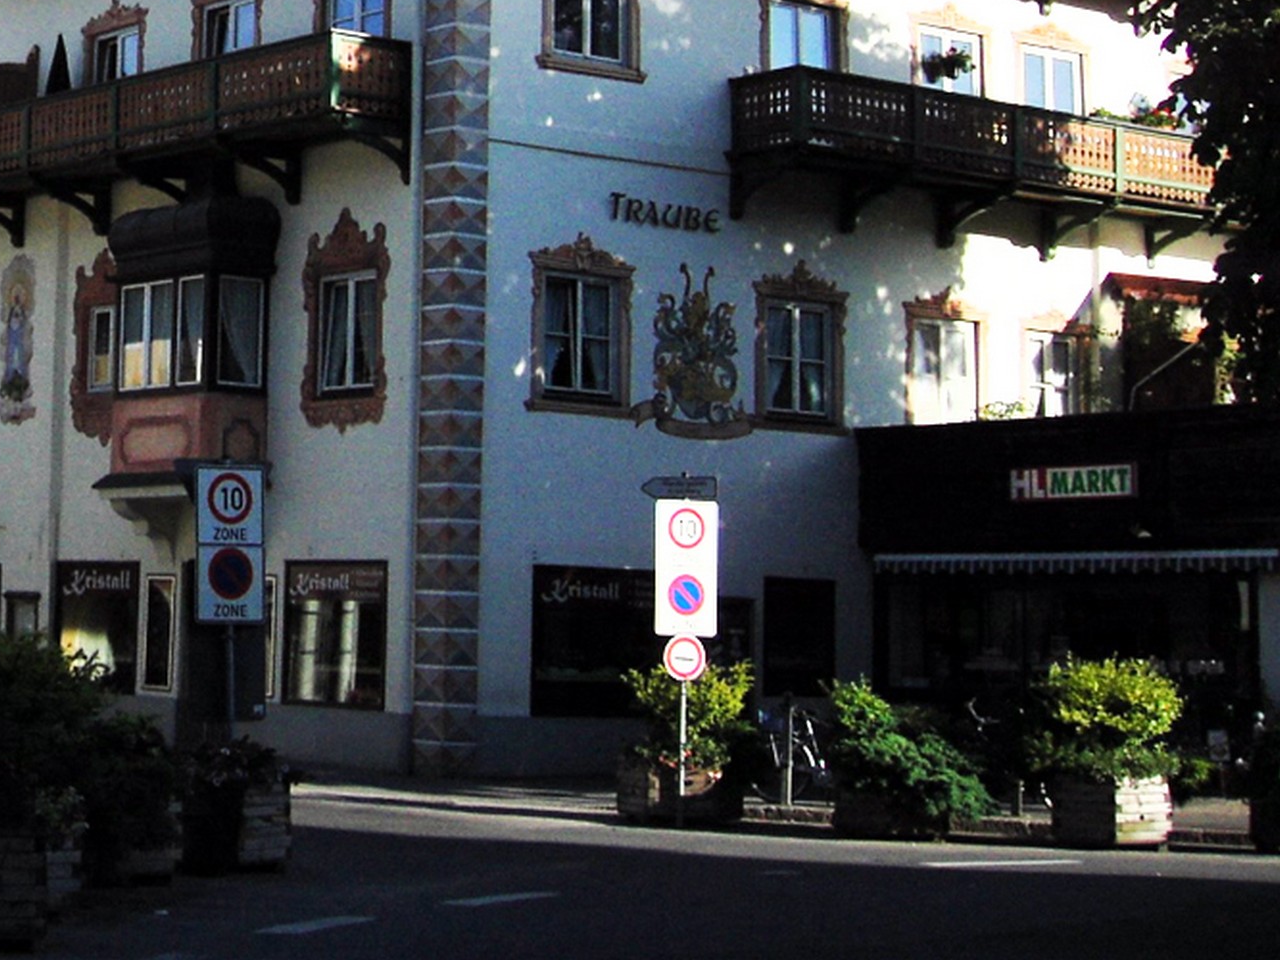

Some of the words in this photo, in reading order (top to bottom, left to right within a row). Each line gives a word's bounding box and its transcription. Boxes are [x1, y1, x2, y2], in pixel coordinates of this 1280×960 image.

[609, 192, 721, 234] TRAUBE
[1010, 469, 1045, 499] HL
[1049, 468, 1129, 495] MARKT
[221, 487, 243, 511] 10
[213, 528, 247, 541] ZONE
[62, 569, 131, 596] Kristall
[289, 573, 349, 596] Kristall
[540, 579, 620, 602] Kristall
[213, 604, 247, 618] ZONE
